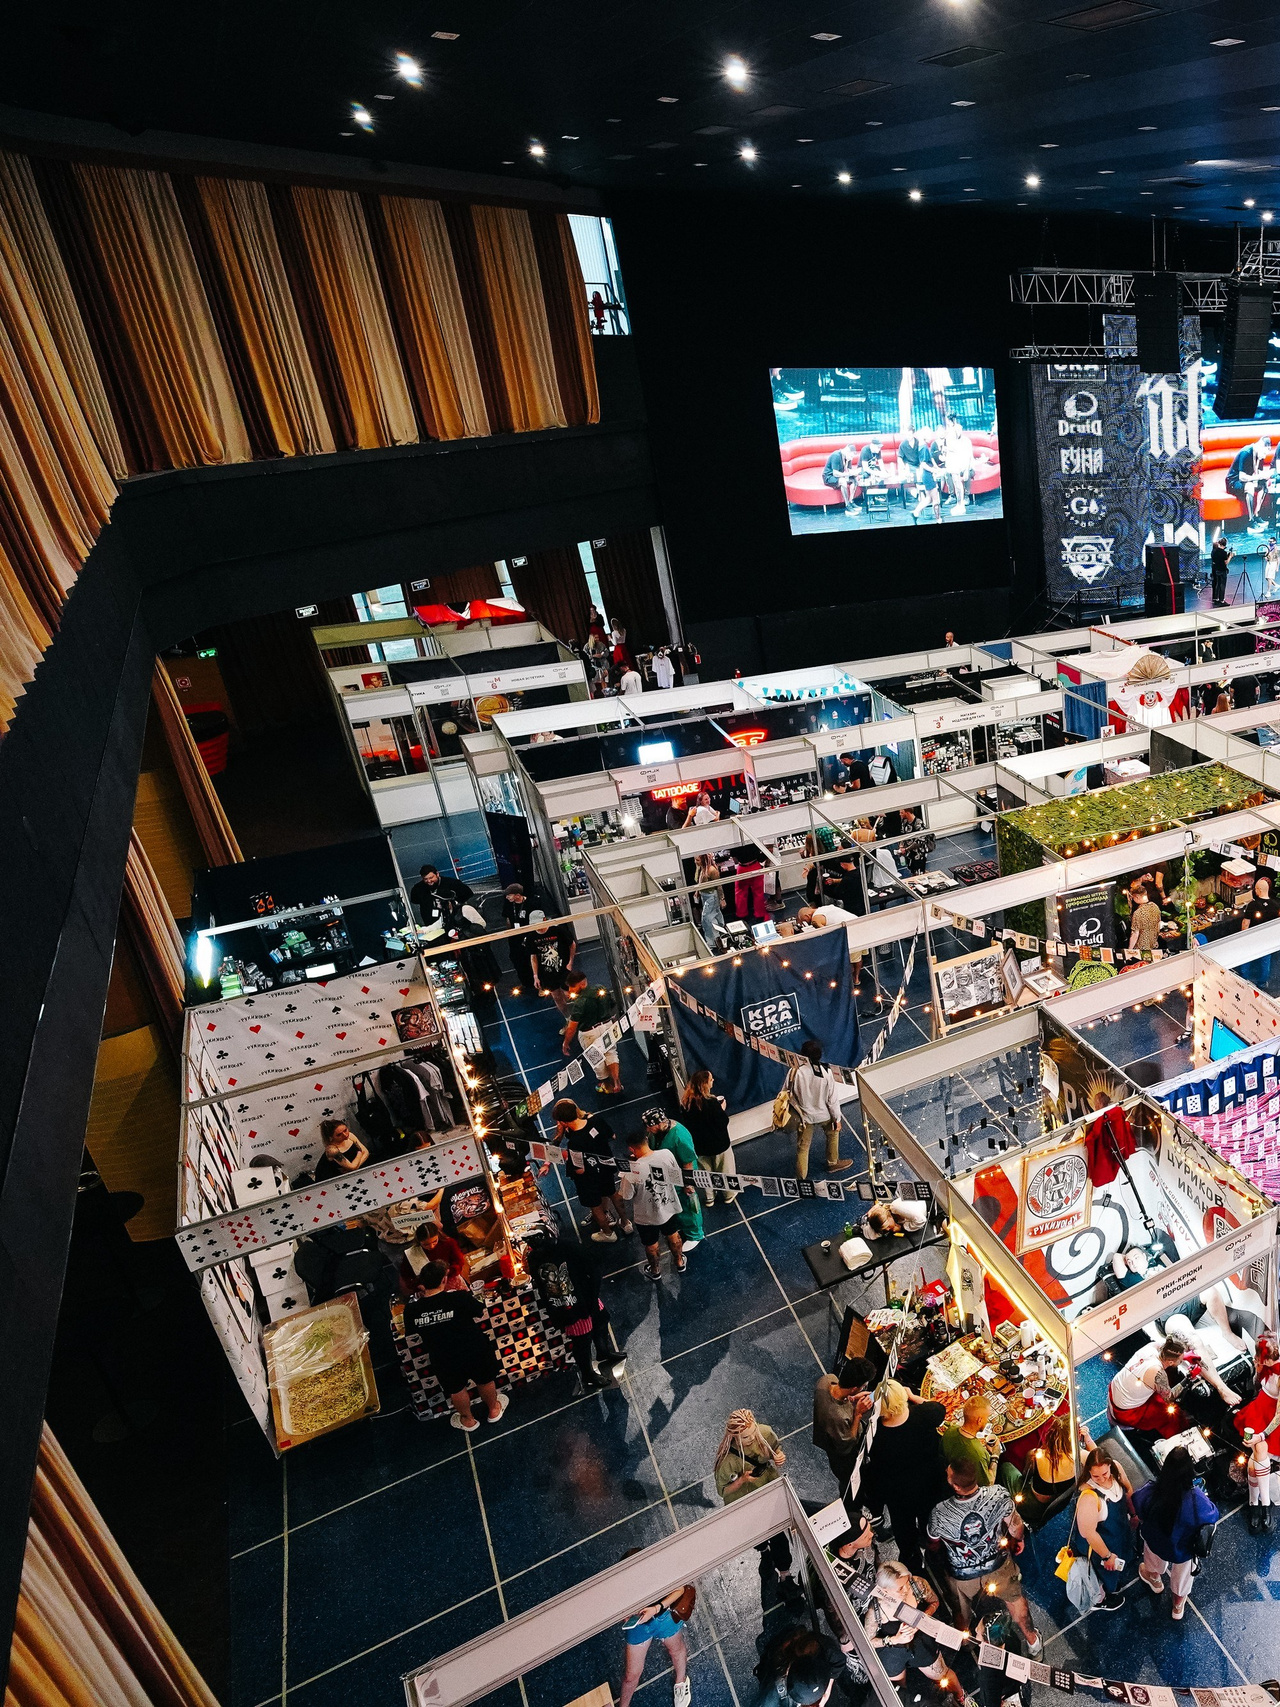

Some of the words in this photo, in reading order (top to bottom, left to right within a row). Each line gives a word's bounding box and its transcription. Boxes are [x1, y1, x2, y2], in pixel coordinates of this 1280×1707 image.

[748, 1000, 791, 1021] КРА
[750, 1010, 793, 1031] СКА
[1166, 1150, 1224, 1208] ЦУРИКОВ
[1177, 1178, 1209, 1214] ИВАН
[1156, 1264, 1203, 1295] РУКИ-КРЮКИ
[1162, 1275, 1198, 1299] ВОРОНЕЖ
[414, 1310, 454, 1326] PRO-TEAM
[1113, 1318, 1121, 1331] 1
